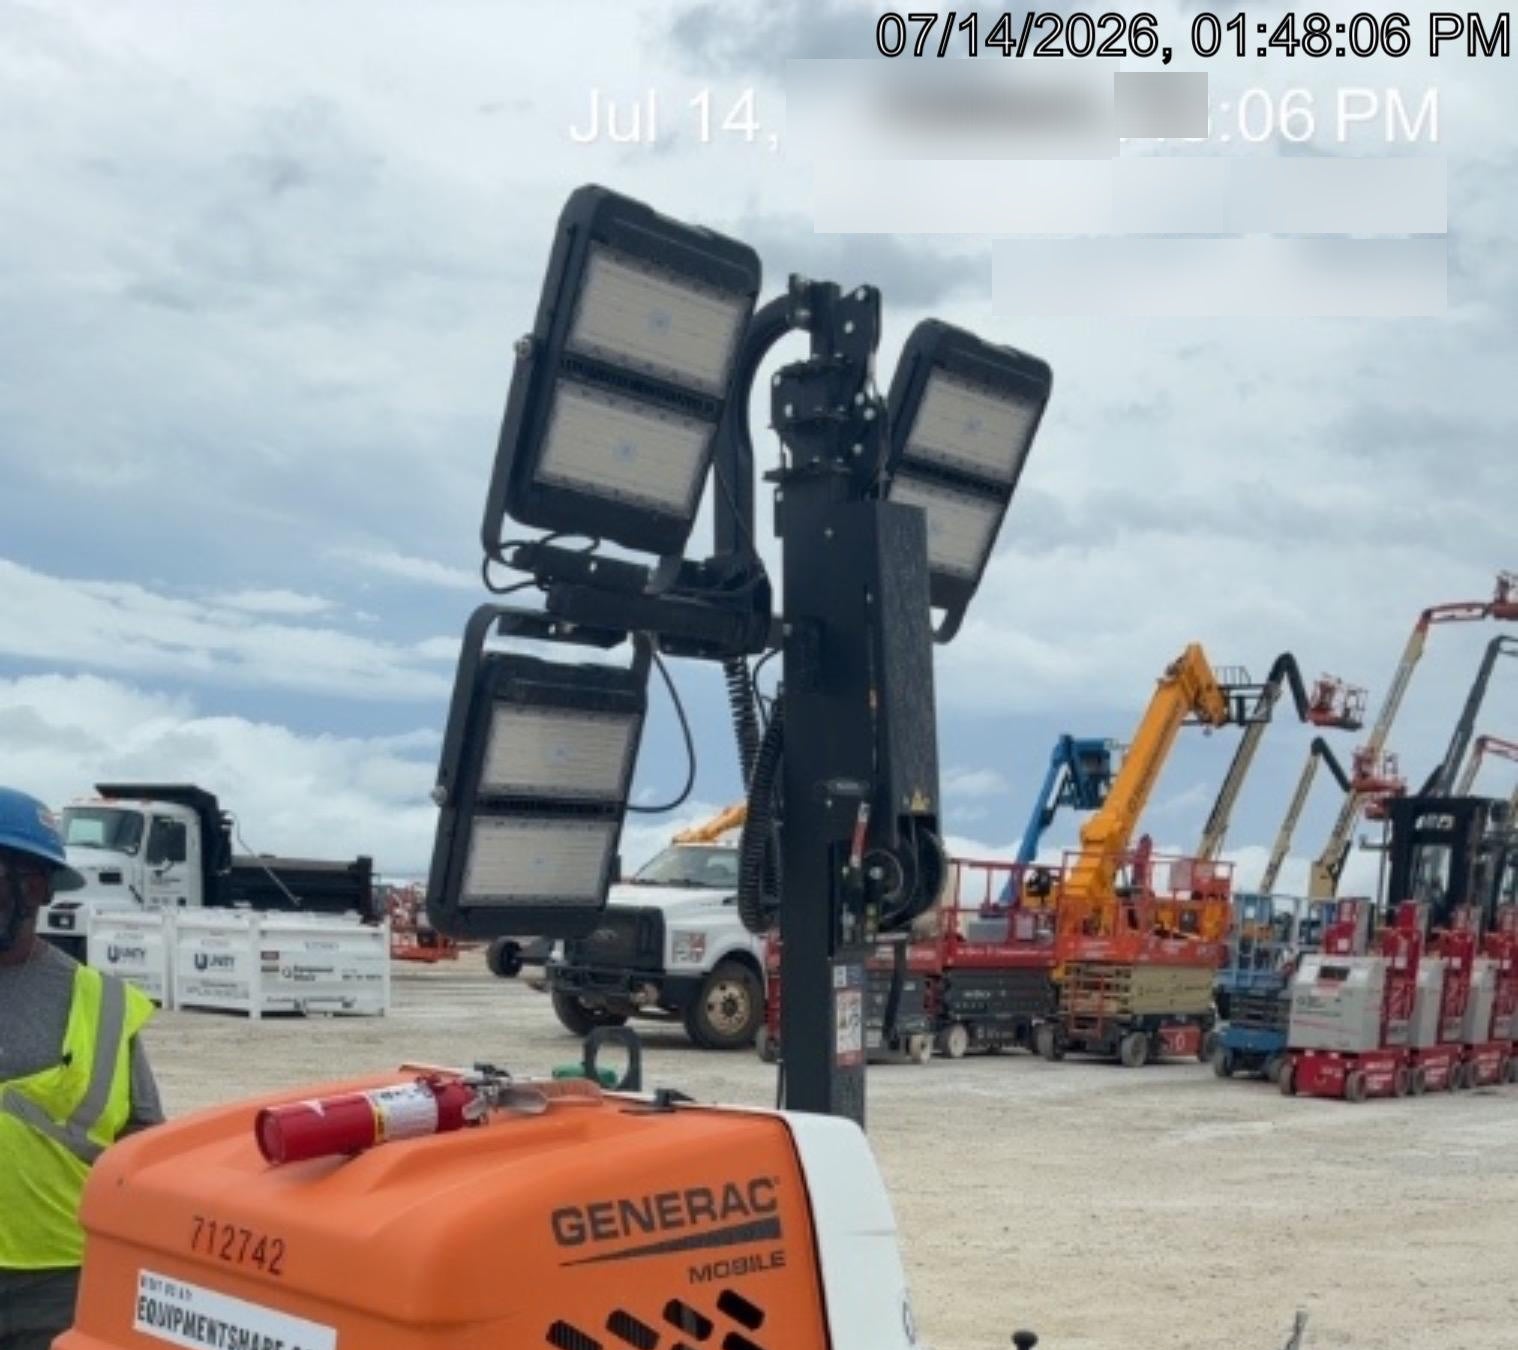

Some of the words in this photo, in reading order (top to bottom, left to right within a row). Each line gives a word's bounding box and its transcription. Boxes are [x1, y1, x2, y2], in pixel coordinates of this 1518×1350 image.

[551, 1177, 778, 1246] GENERAC
[190, 1215, 285, 1276] 712742
[688, 1250, 786, 1285] MOBILE
